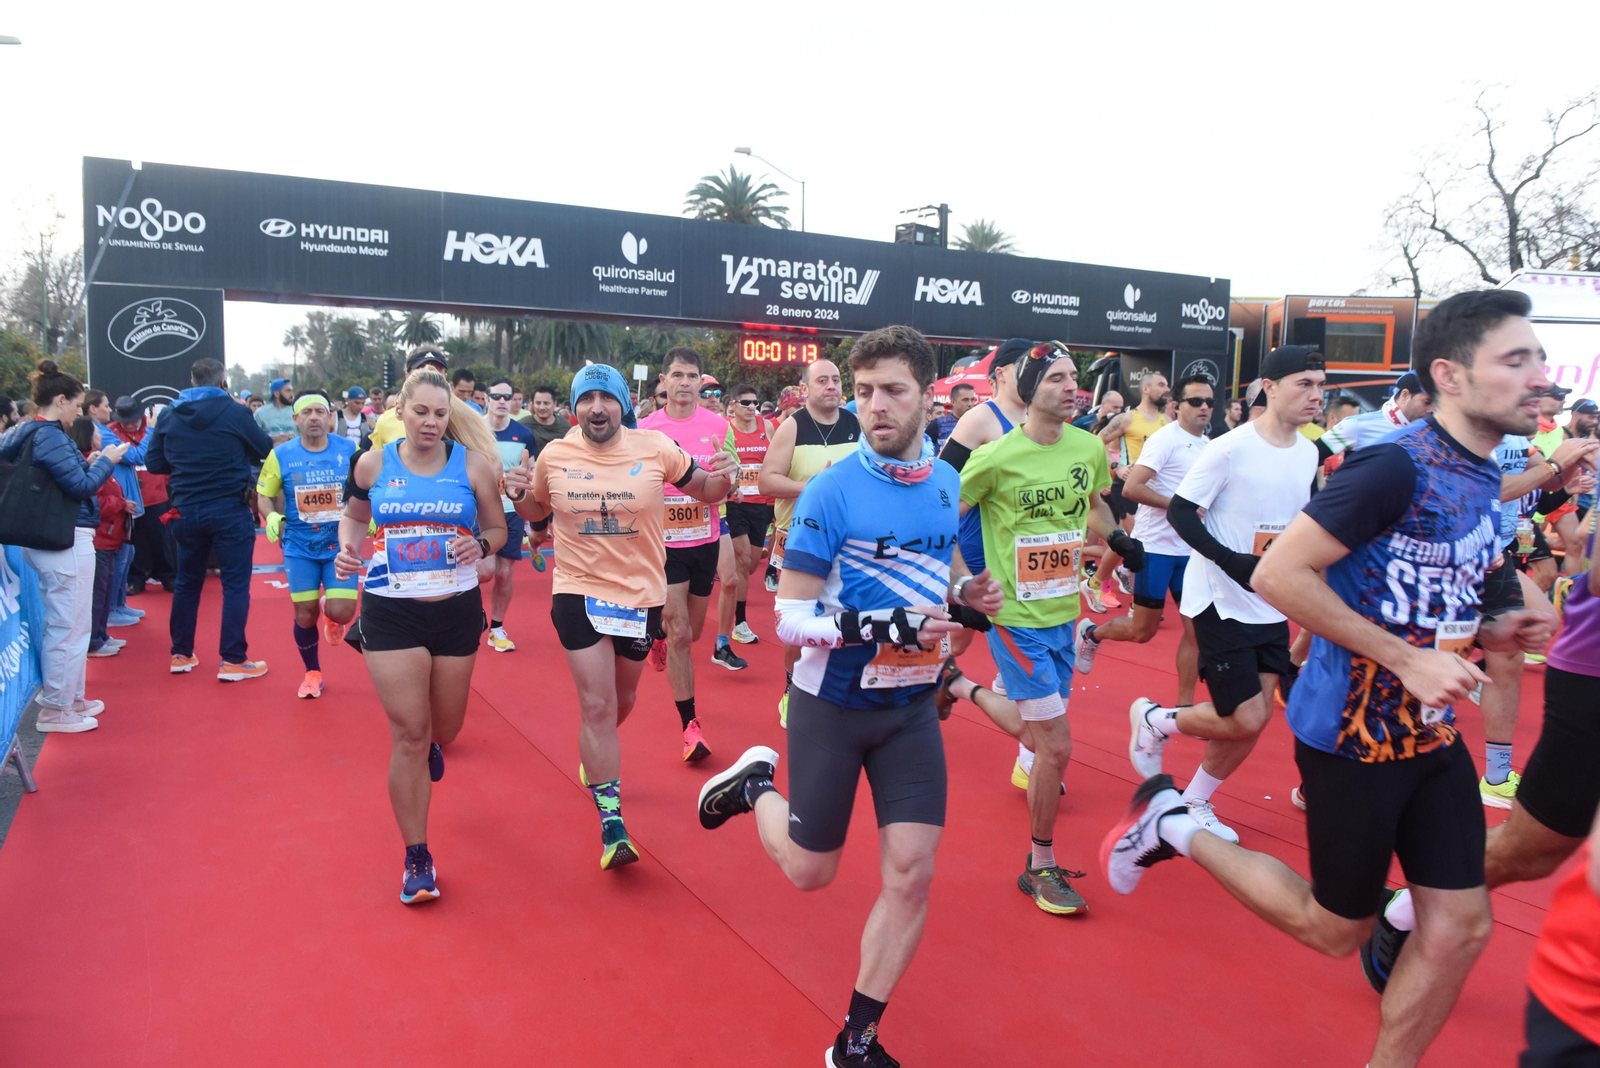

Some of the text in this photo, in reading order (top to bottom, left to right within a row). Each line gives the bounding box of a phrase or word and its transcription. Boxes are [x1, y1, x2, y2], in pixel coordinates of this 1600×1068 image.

[301, 223, 389, 244] HYUNDAI
[162, 242, 173, 250] DE
[300, 241, 388, 256] Hyundauto Motor
[443, 230, 547, 268] HOKA
[592, 264, 675, 283] quirónsalud
[753, 257, 858, 285] maratón
[599, 283, 668, 297] Healthcare Partner
[780, 280, 861, 305] sevilla
[914, 276, 983, 306] HOKA
[1033, 292, 1080, 307] HYUNDAI
[766, 304, 839, 320] 28 enero 2024
[1032, 306, 1079, 316] Hyundauto Motor
[1106, 309, 1157, 323] quirónsalud
[153, 325, 161, 333] de
[161, 323, 188, 335] Canarias
[743, 340, 818, 364] 00:01:13
[1070, 467, 1088, 491] 30
[303, 492, 333, 506] 4469
[1036, 486, 1065, 503] BCN
[379, 500, 463, 515] enerplus
[668, 506, 699, 521] 3601
[396, 540, 441, 562] 1883
[1387, 532, 1451, 567] MEDIO
[1028, 548, 1070, 570] 5796
